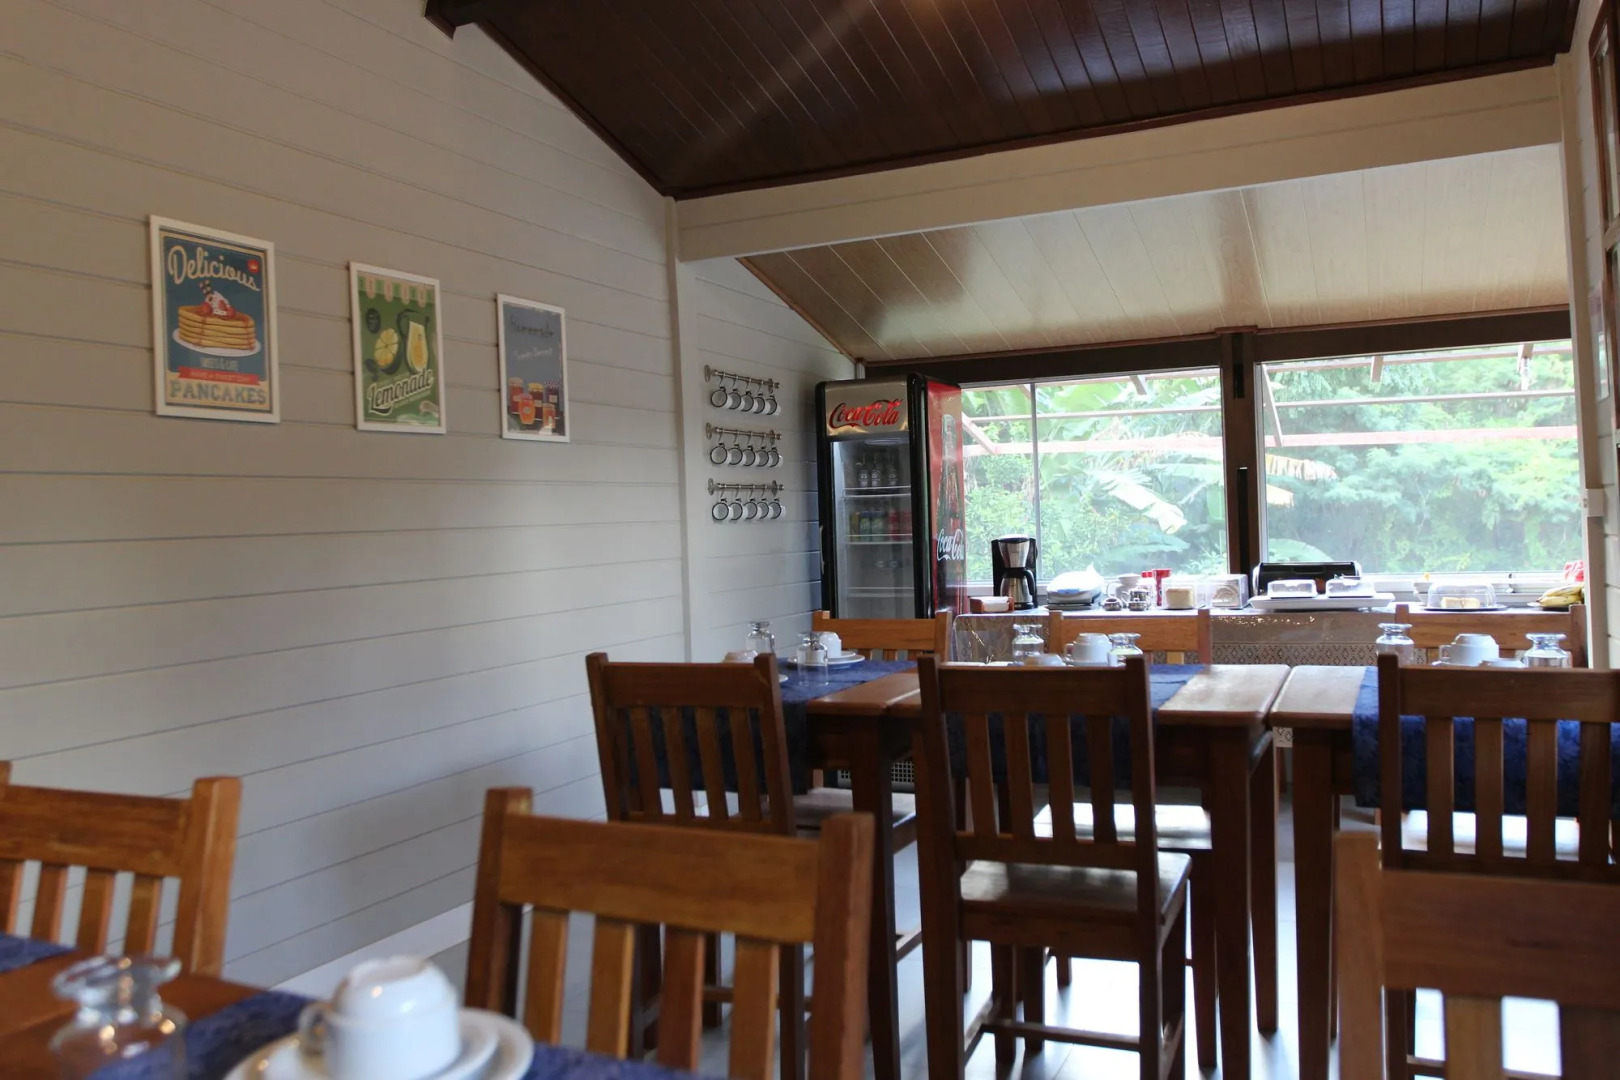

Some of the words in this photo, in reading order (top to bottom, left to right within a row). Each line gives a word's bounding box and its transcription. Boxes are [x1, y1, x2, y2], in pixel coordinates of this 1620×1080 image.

[168, 245, 261, 291] Delicious
[169, 380, 267, 405] PANCAKES
[368, 369, 435, 416] Lemonade
